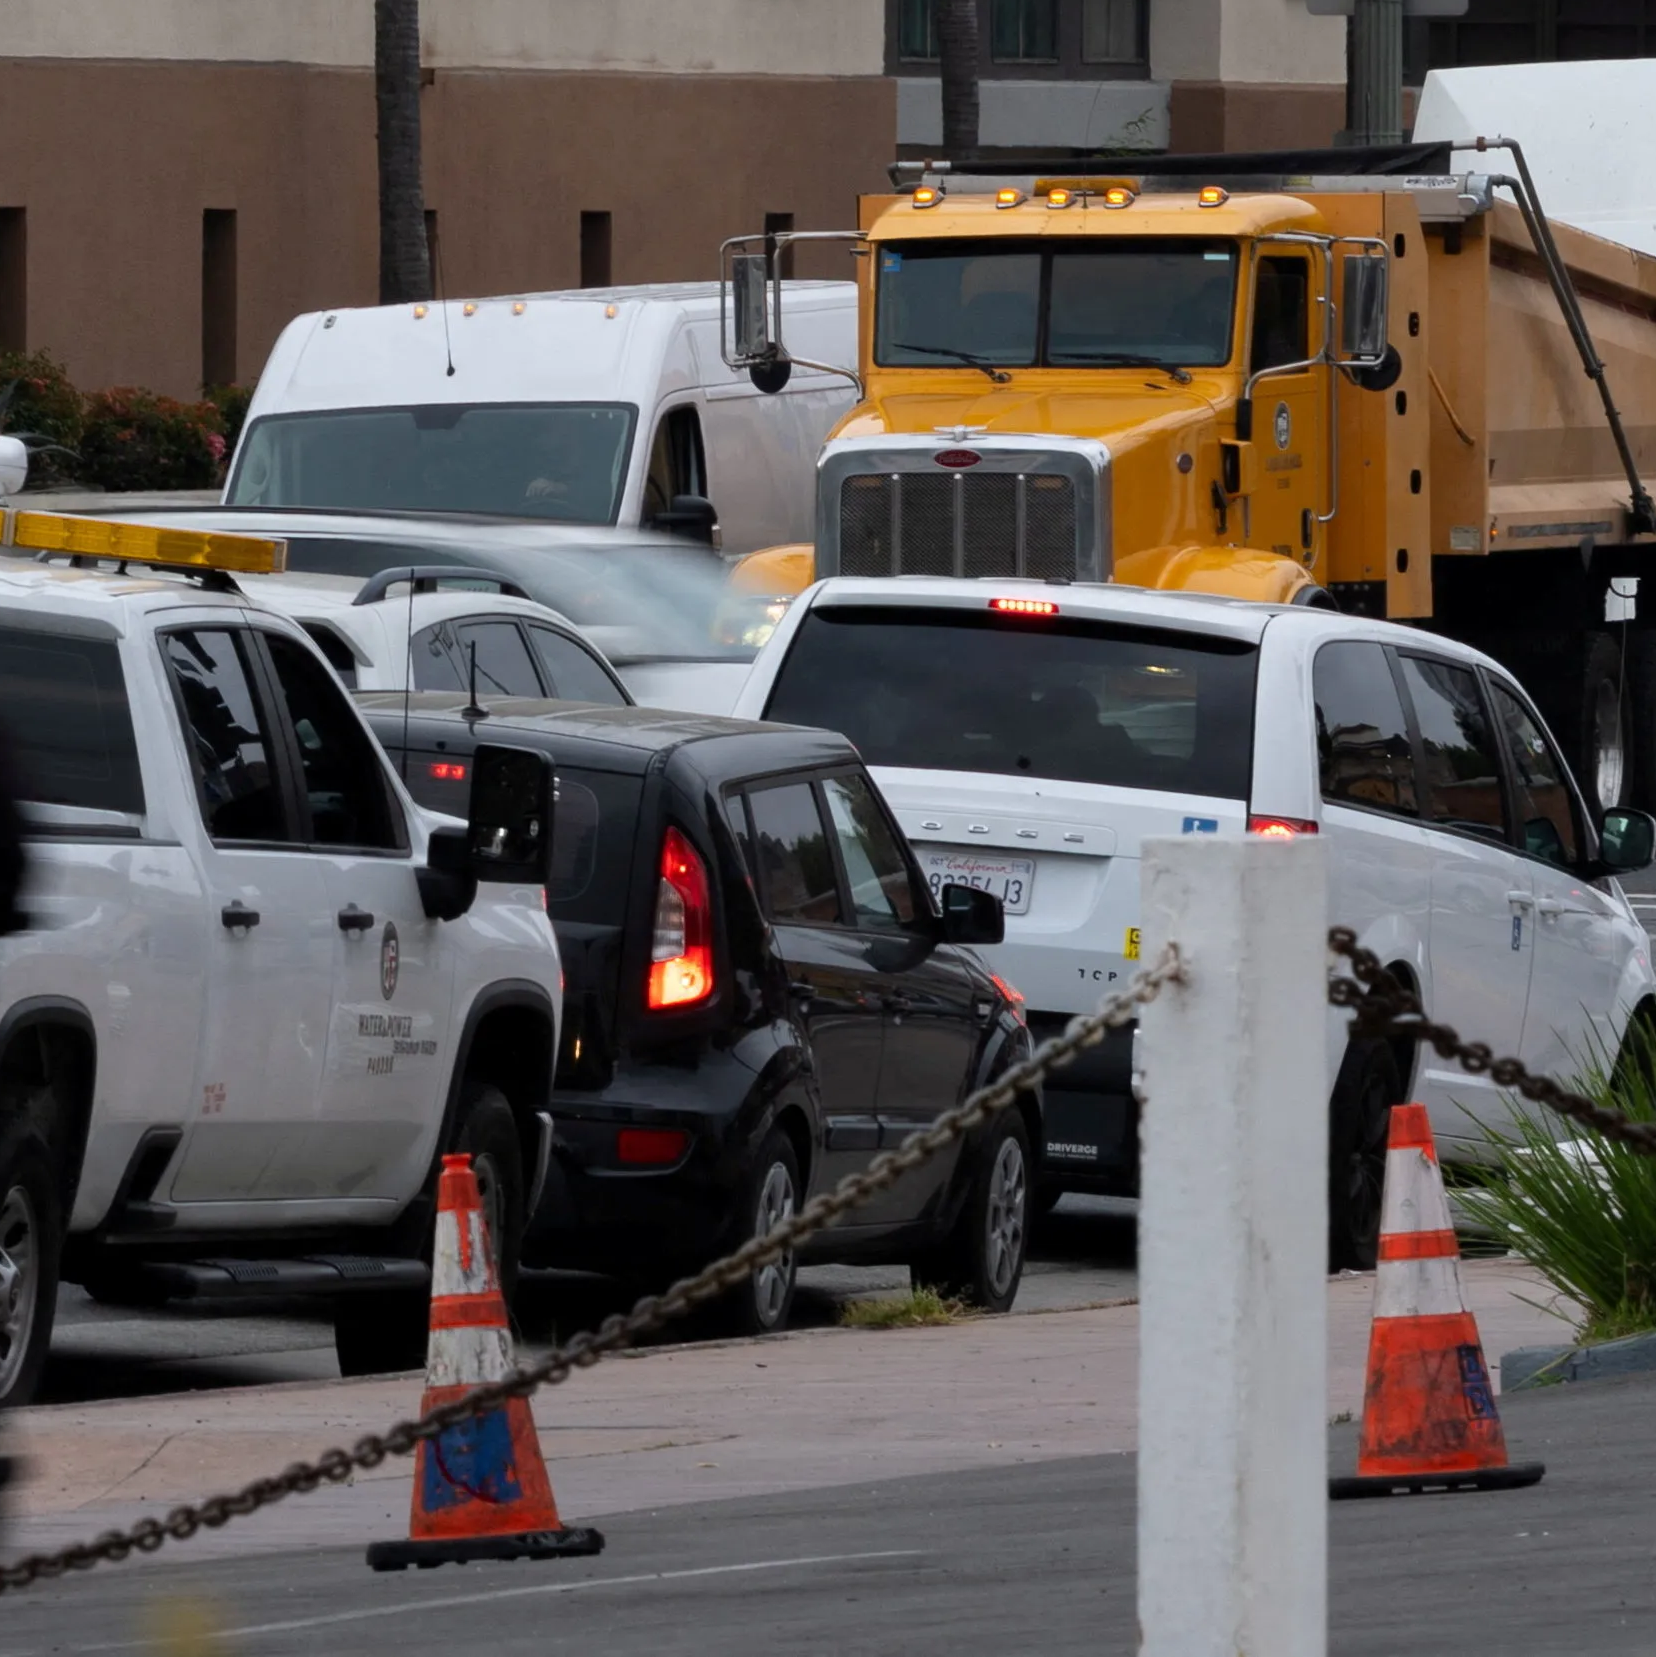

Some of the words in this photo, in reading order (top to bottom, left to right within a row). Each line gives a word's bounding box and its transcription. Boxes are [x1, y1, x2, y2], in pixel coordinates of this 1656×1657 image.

[920, 820, 1085, 843] ODGE
[946, 856, 1011, 874] California
[1046, 1141, 1098, 1155] DRIVERGE
